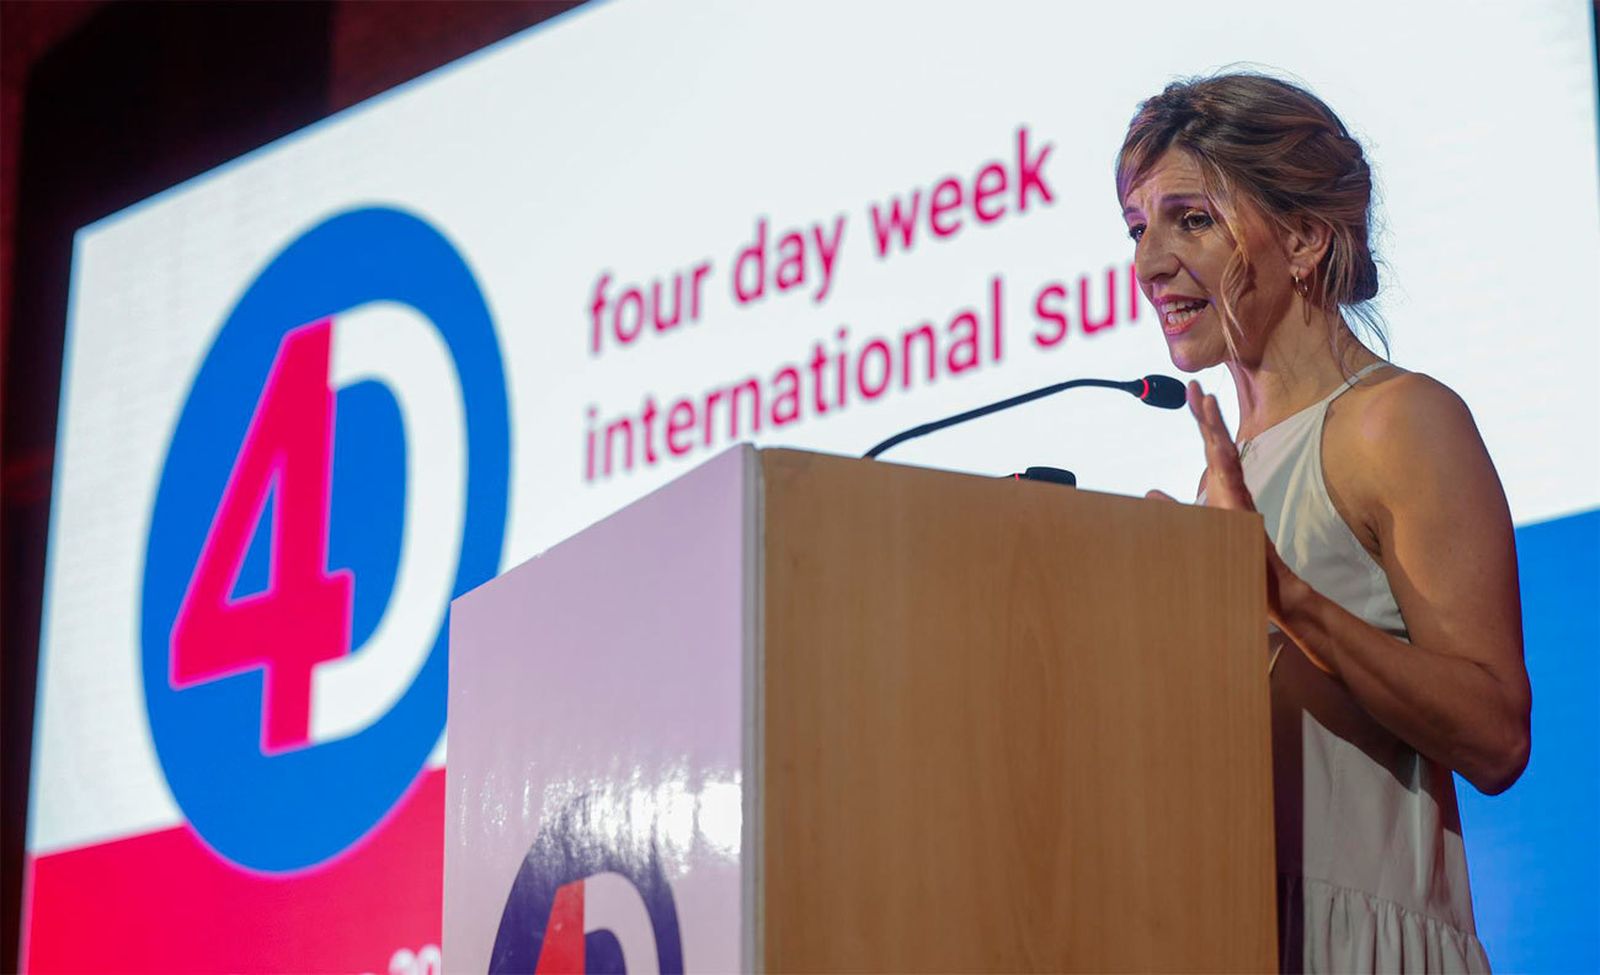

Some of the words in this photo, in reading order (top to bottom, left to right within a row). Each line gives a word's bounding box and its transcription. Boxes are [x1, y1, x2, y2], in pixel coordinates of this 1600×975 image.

[589, 265, 710, 353] four
[732, 218, 845, 302] day
[870, 127, 1055, 257] week
[586, 277, 1003, 480] international
[170, 300, 466, 756] 4D
